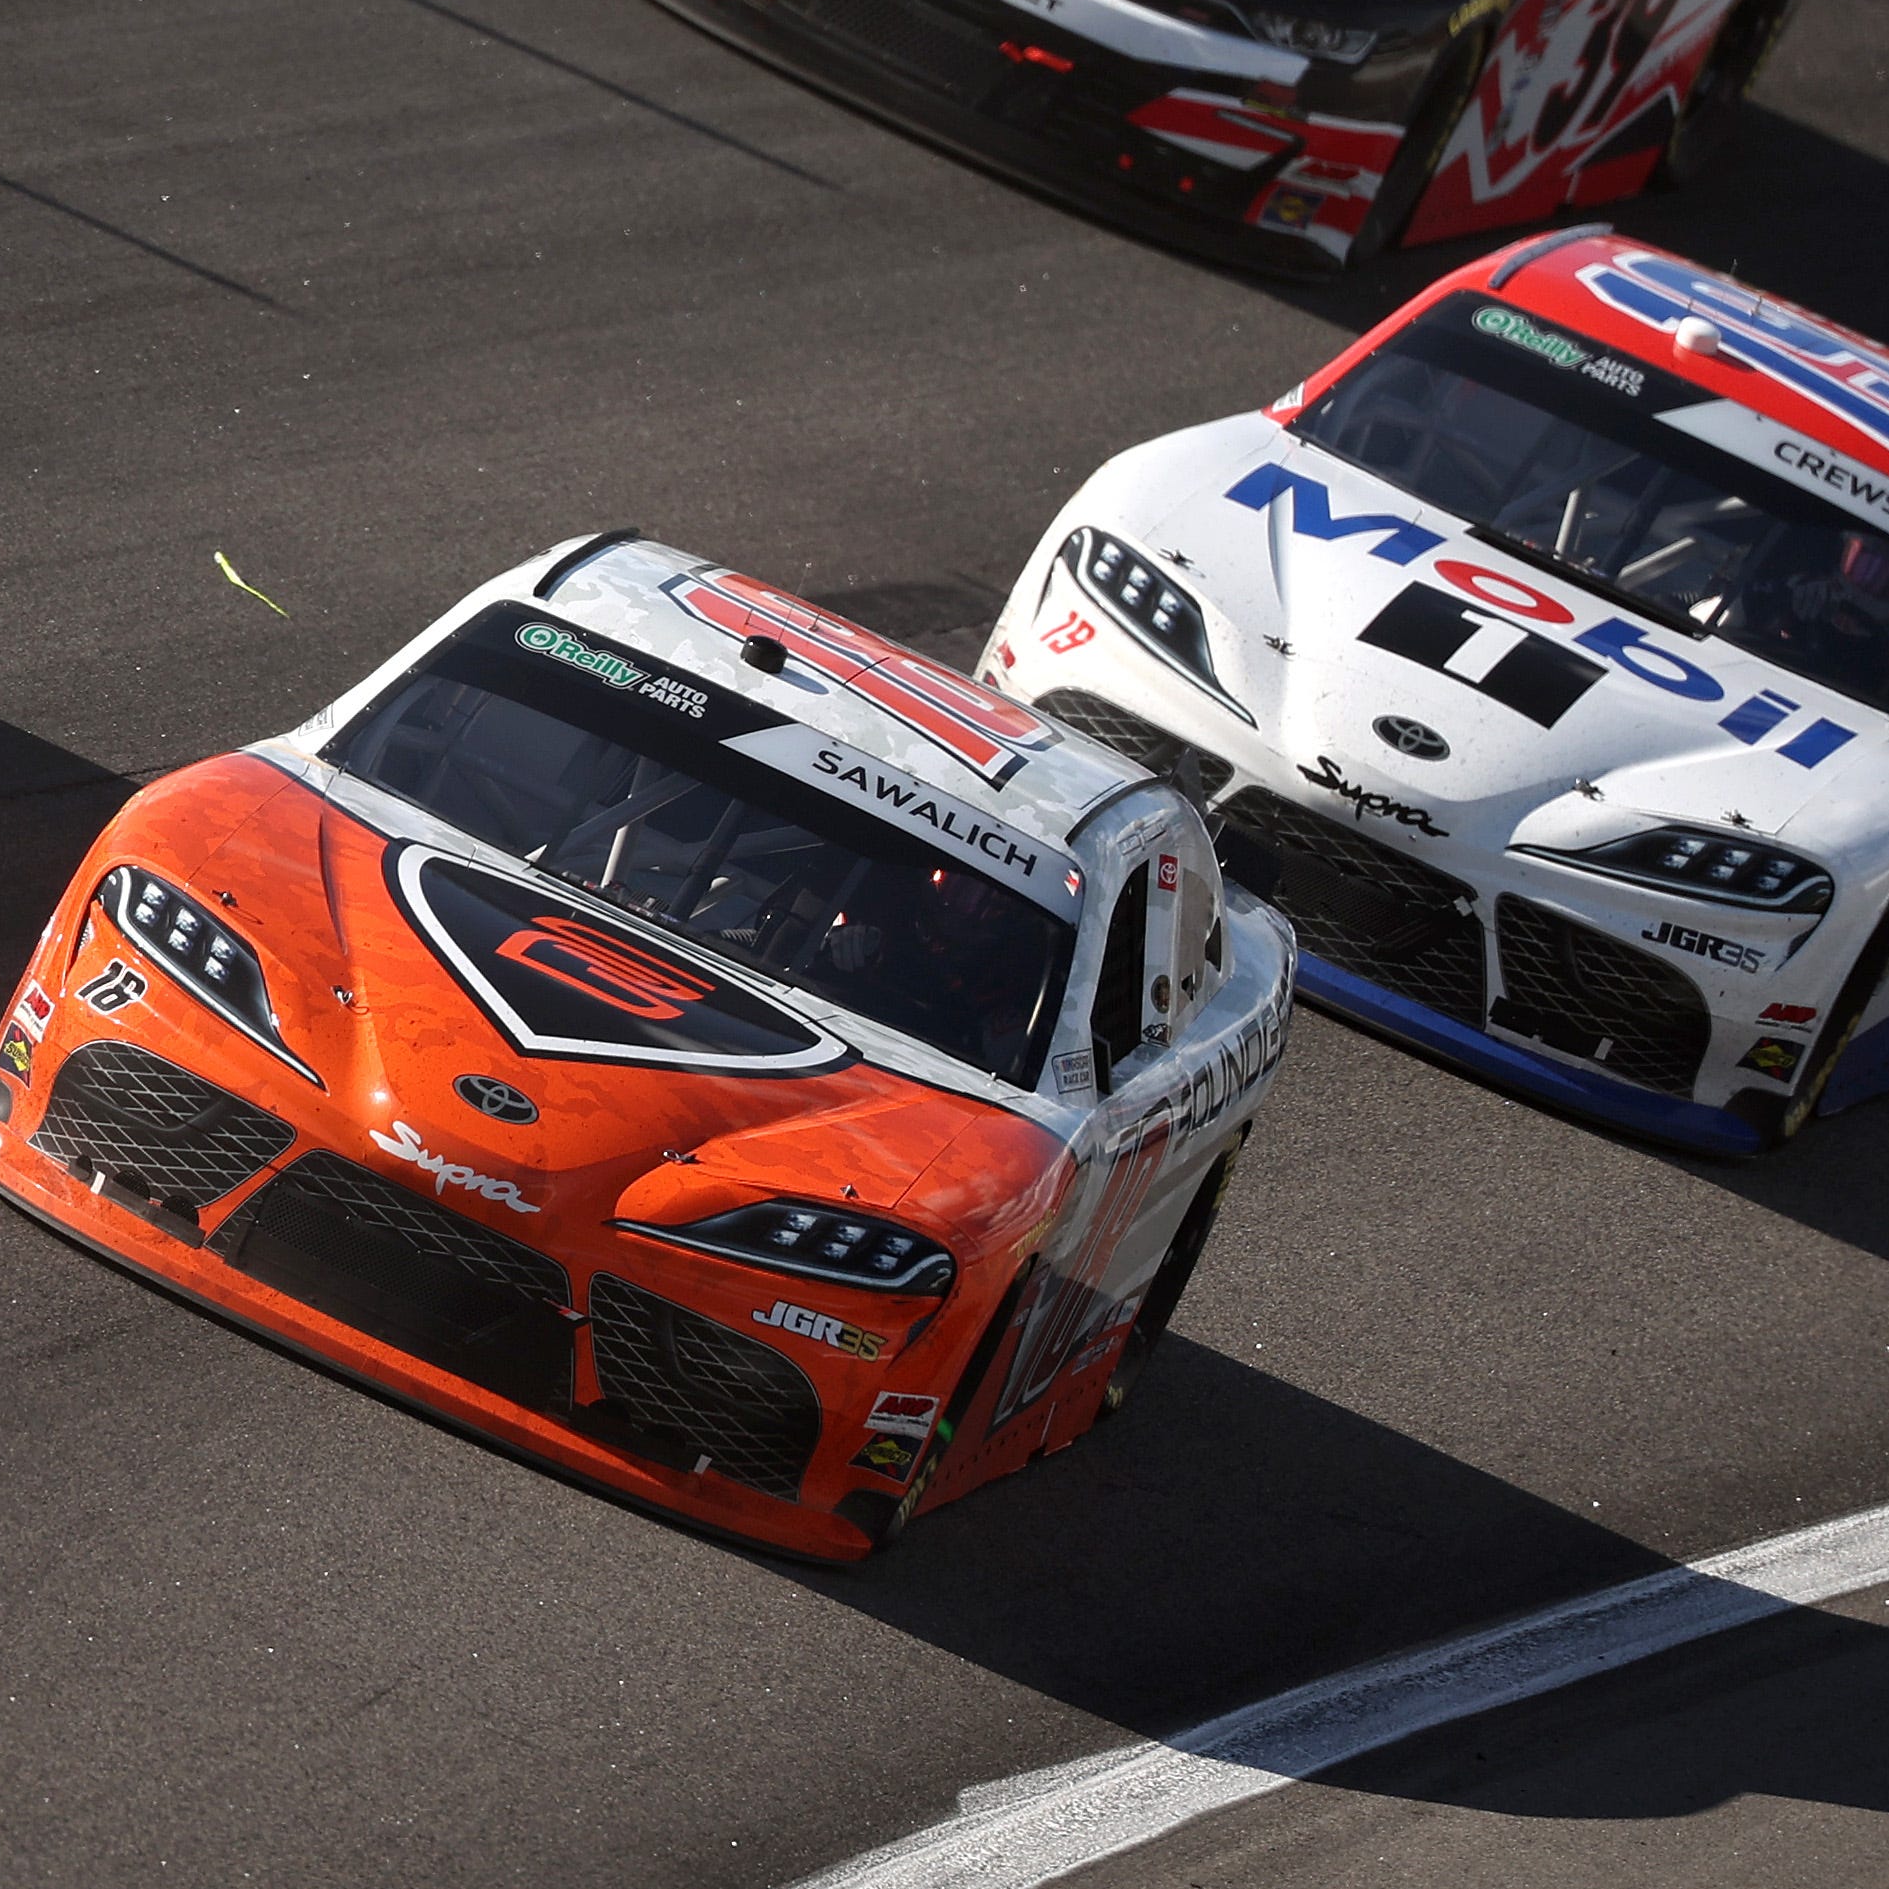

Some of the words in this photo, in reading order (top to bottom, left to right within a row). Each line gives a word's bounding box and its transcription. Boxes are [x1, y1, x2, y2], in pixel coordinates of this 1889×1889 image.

[1581, 362, 1643, 398] PARTS
[1593, 355, 1646, 386] AUTO
[1039, 610, 1097, 655] 19
[1224, 461, 1858, 771] Mobil
[1442, 607, 1530, 686] 1
[514, 622, 652, 690] O'Reilly
[638, 681, 707, 719] PARTS
[653, 676, 709, 705] AUTO
[811, 747, 1038, 877] SAWALICH
[1297, 755, 1451, 840] Supra
[73, 957, 149, 1016] 18
[368, 1119, 542, 1214] Supra
